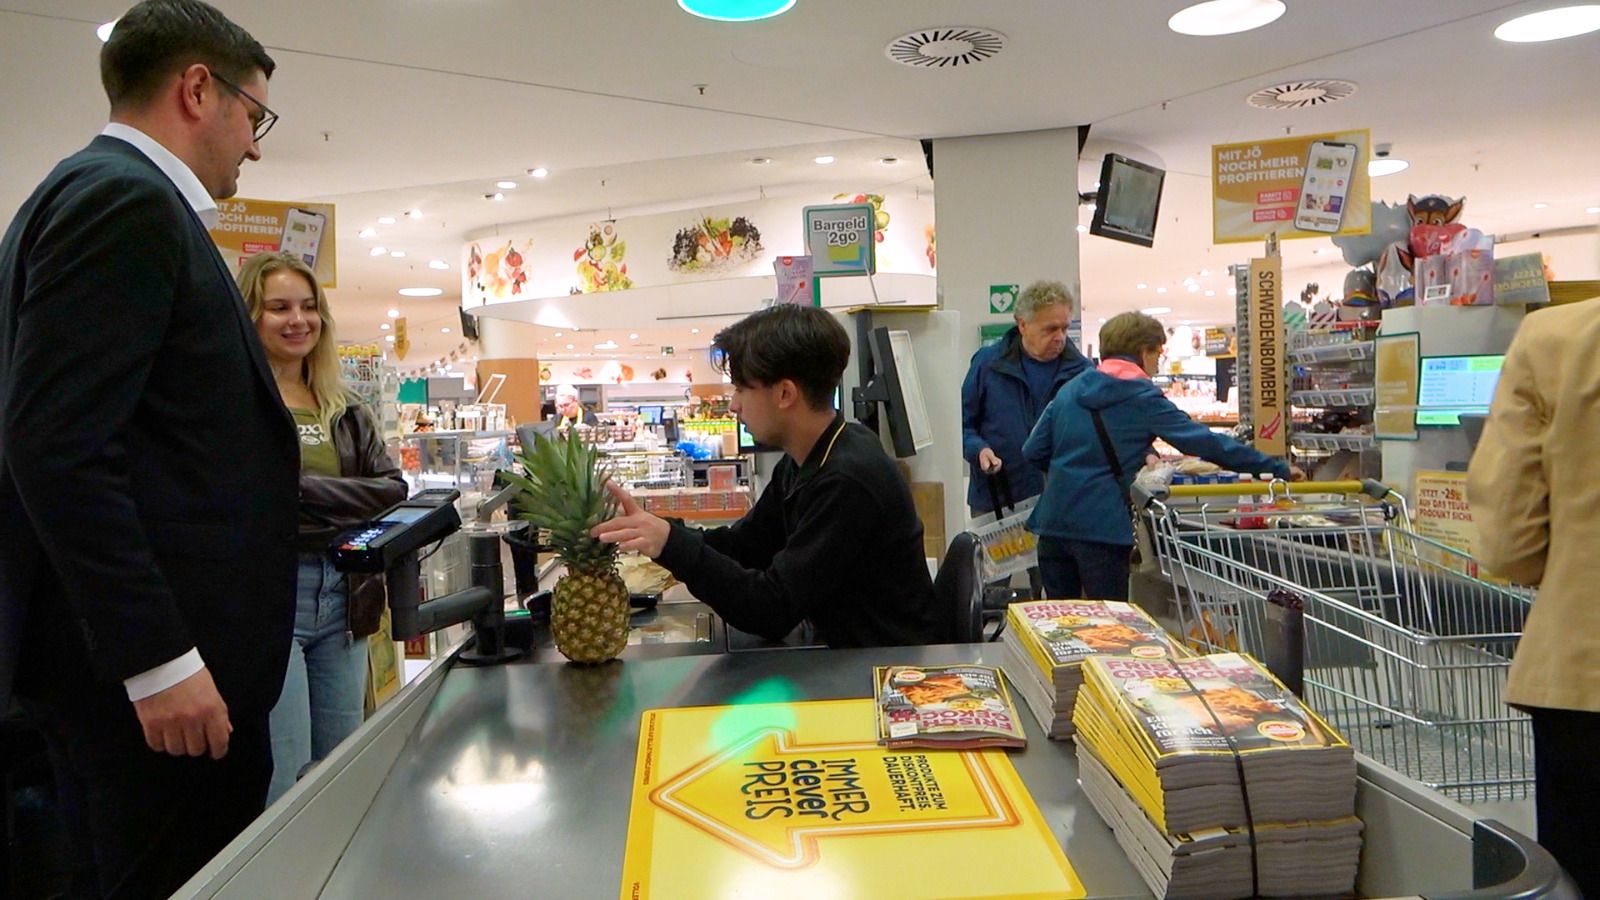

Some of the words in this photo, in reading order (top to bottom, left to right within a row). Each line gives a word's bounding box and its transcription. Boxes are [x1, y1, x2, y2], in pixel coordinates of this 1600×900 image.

[1218, 150, 1242, 161] MIT
[1244, 146, 1262, 160] JÖ
[1218, 160, 1257, 173] NOCH
[1260, 156, 1298, 169] MEHR
[1218, 167, 1305, 185] PROFITIEREN
[217, 212, 242, 223] OCH
[244, 214, 279, 225] MEHR
[813, 217, 866, 231] Bargeld
[829, 231, 857, 245] 2go
[1258, 270, 1277, 409] SCHWEDENBOMBEN
[923, 718, 1013, 731] FRISCH
[740, 760, 794, 820] PREIS
[789, 759, 829, 818] clever
[821, 758, 870, 821] IMMER
[882, 756, 916, 812] DAUERHAFT.
[900, 756, 932, 811] DISKONTPREIS.
[914, 754, 941, 791] PRODUKTE
[930, 792, 948, 810] ZUM
